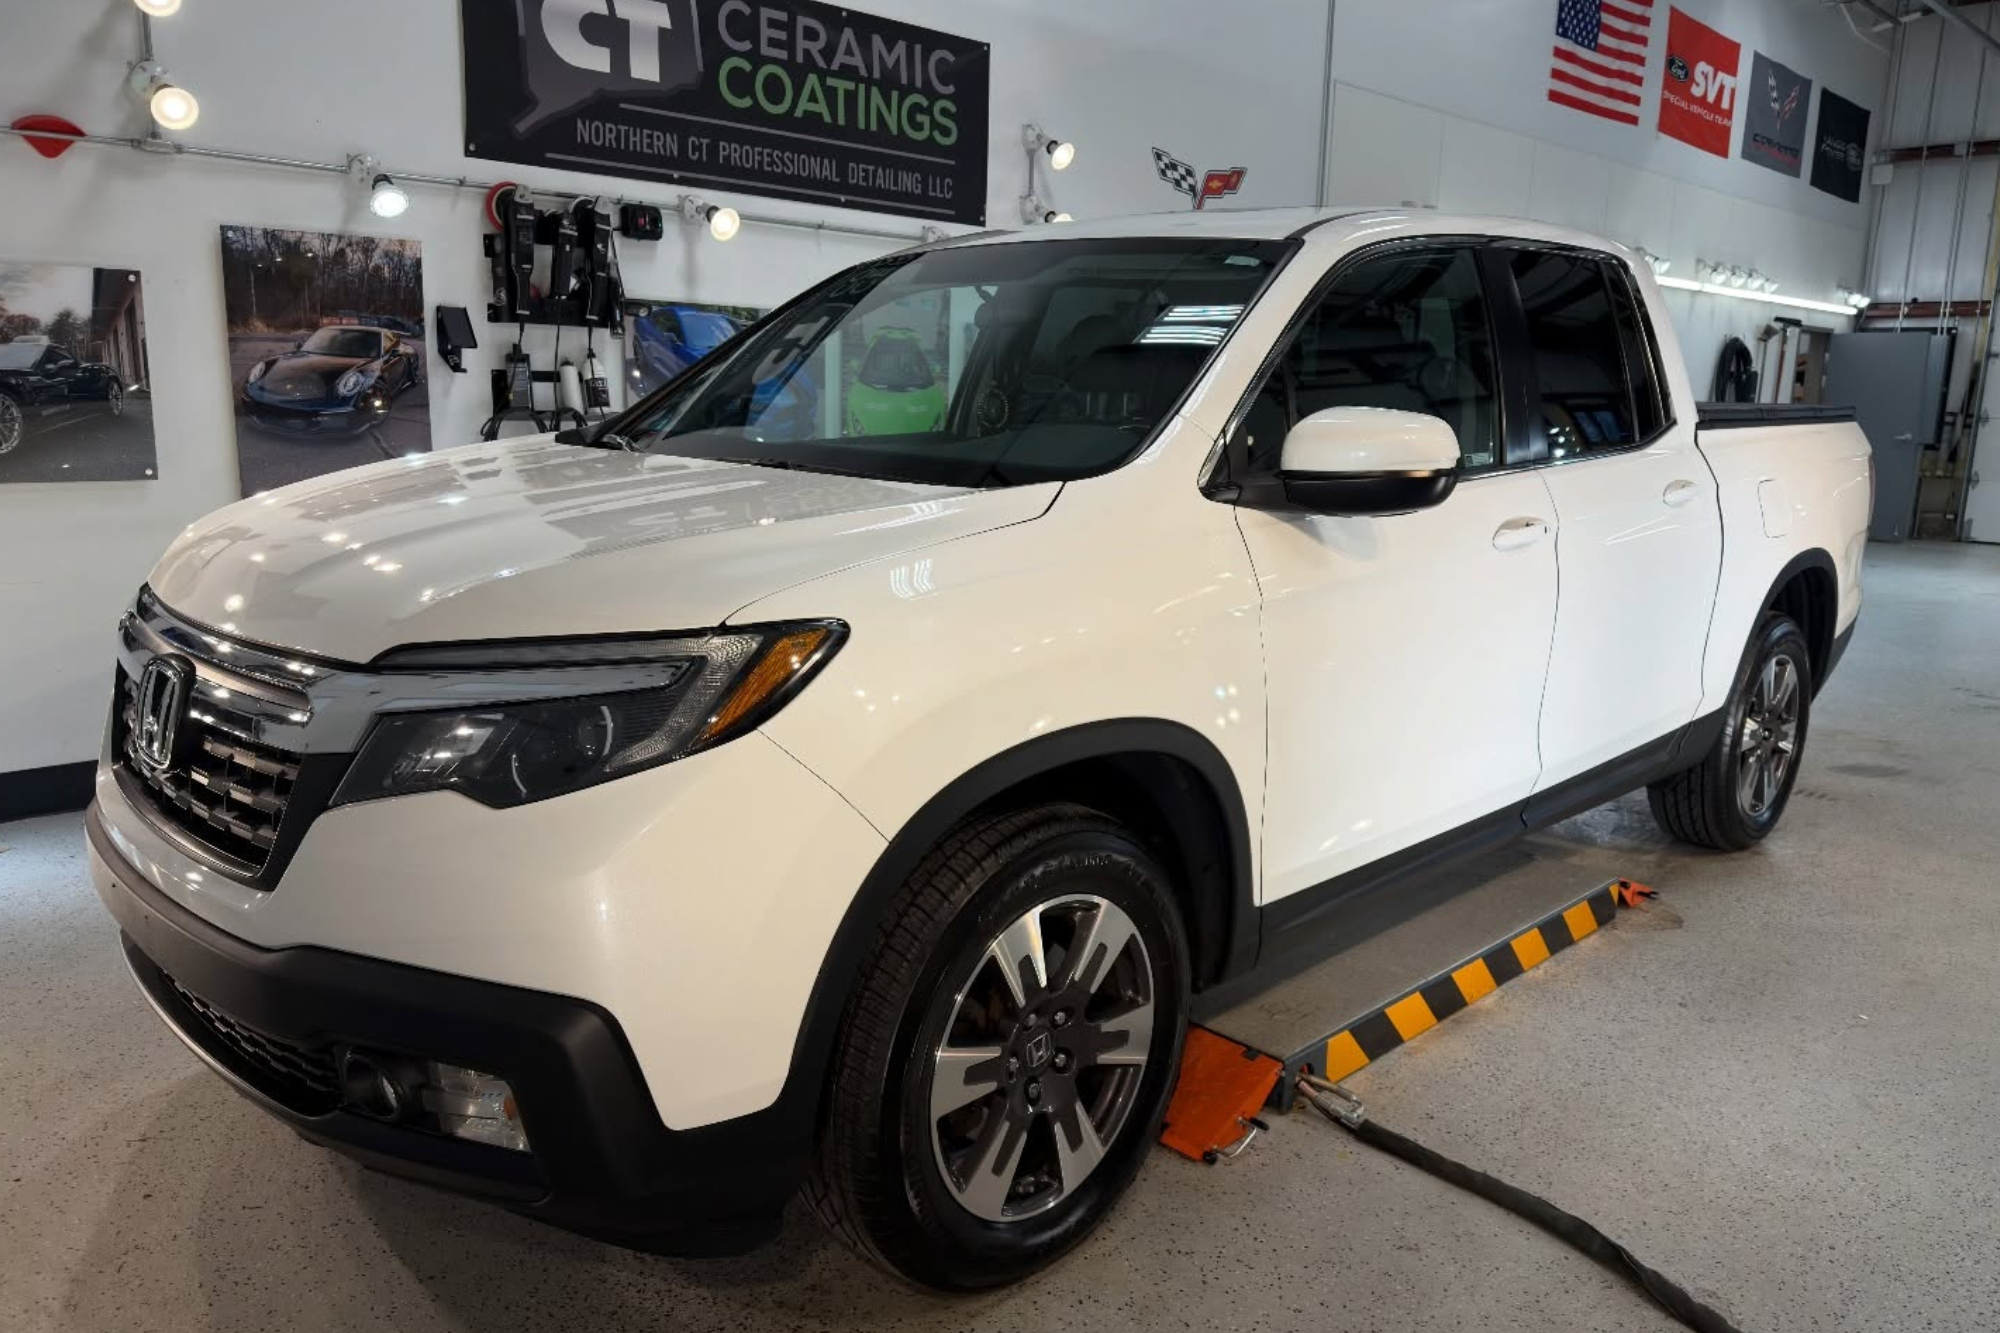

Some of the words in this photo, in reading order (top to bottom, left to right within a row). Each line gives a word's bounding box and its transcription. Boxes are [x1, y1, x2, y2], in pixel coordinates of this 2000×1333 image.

[541, 0, 672, 83] CT
[718, 0, 956, 95] CERAMIC
[718, 56, 958, 146] COATINGS
[1663, 90, 1690, 110] SPECIAL
[1690, 61, 1737, 110] SVT
[577, 117, 679, 158] NORTHERN
[688, 136, 711, 162] CT
[719, 141, 840, 182] PROFESSIONAL
[848, 162, 922, 195] DETAILING
[928, 174, 953, 198] LLC
